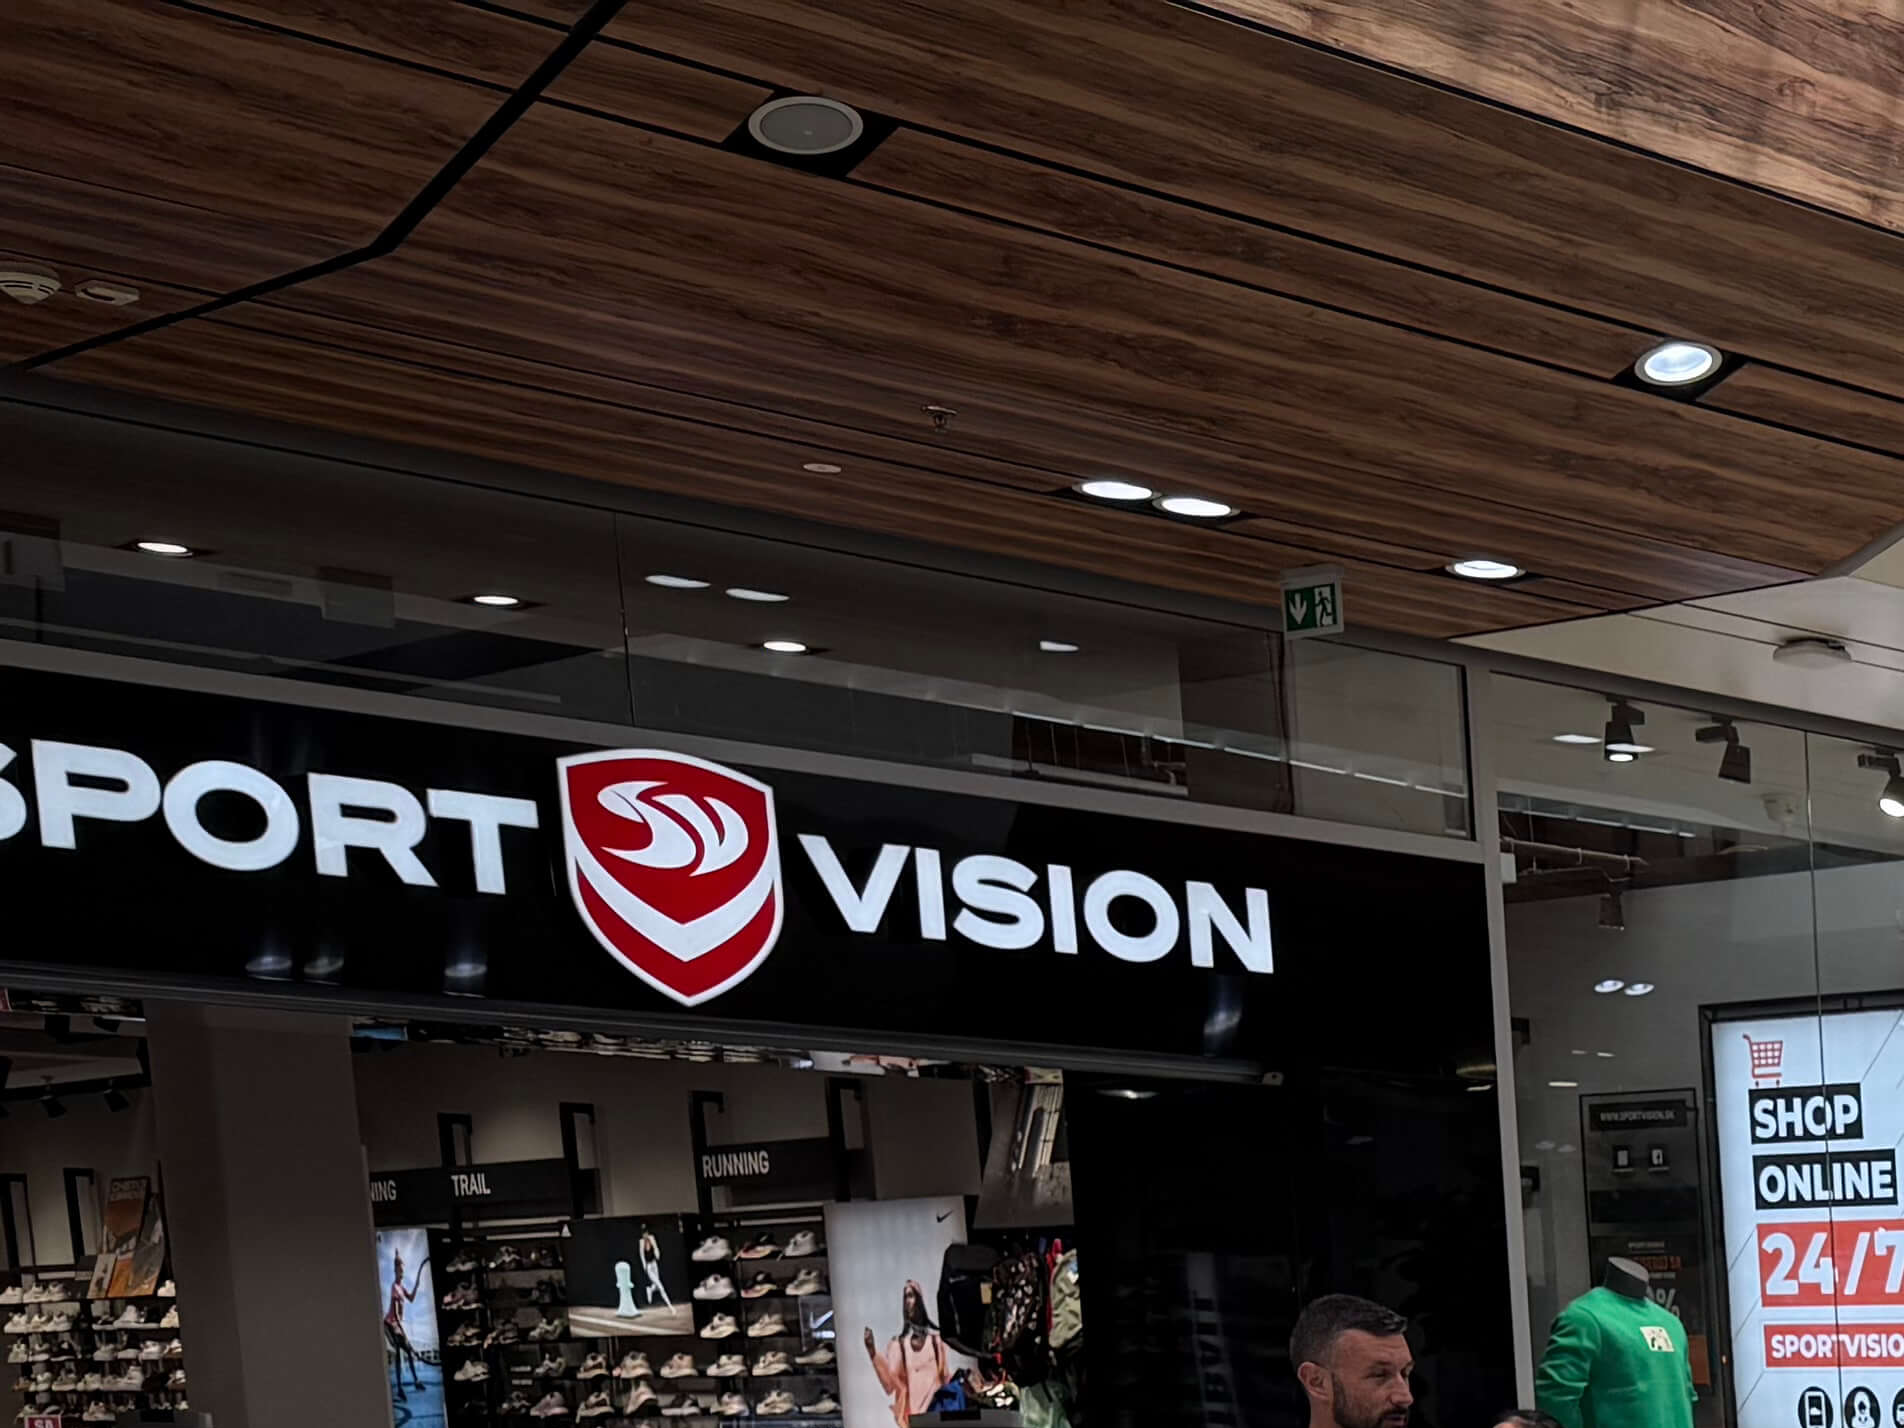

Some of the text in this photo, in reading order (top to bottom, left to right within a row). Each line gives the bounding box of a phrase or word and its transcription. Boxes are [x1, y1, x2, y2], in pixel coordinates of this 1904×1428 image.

[0, 738, 1273, 974] PORT VISION
[1753, 1094, 1860, 1138] SHOP
[702, 1152, 769, 1178] RUNNING
[1759, 1161, 1894, 1201] ONLINE
[451, 1174, 491, 1197] TRAIL
